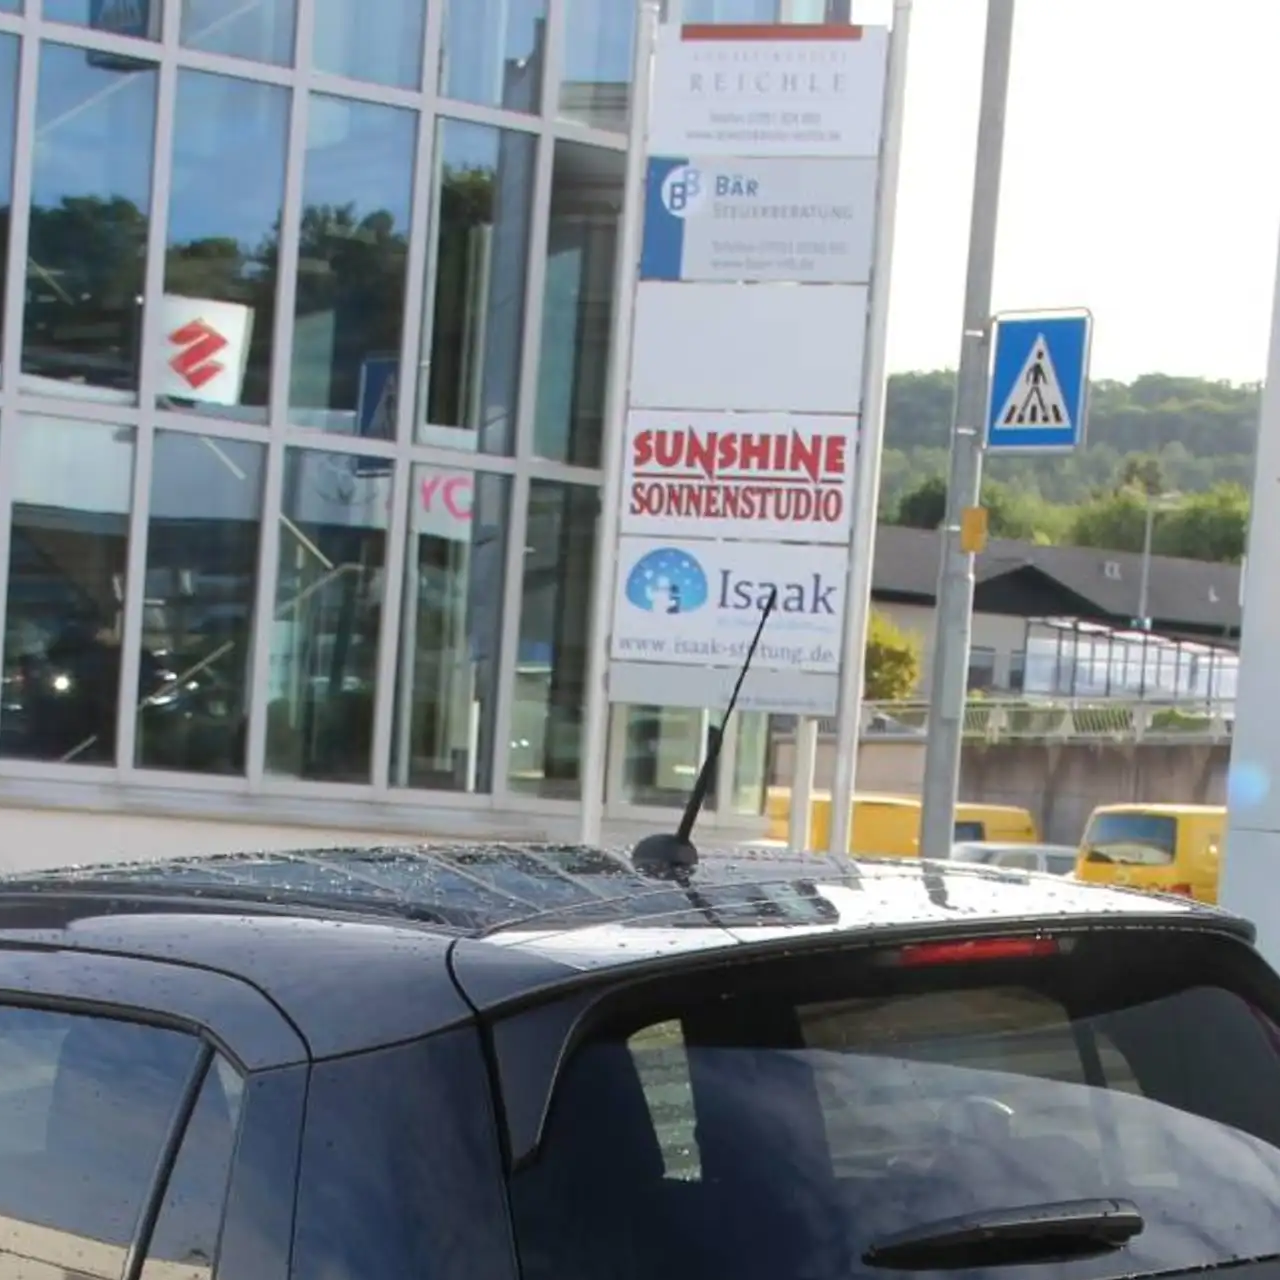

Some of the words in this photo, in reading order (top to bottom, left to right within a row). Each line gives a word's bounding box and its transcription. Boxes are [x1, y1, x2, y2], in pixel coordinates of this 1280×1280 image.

[689, 71, 847, 93] REICHLE
[715, 174, 760, 197] BÄR
[632, 425, 847, 483] SUNSHINE
[630, 482, 843, 521] SONNENSTUDIO
[718, 569, 837, 614] Isaak
